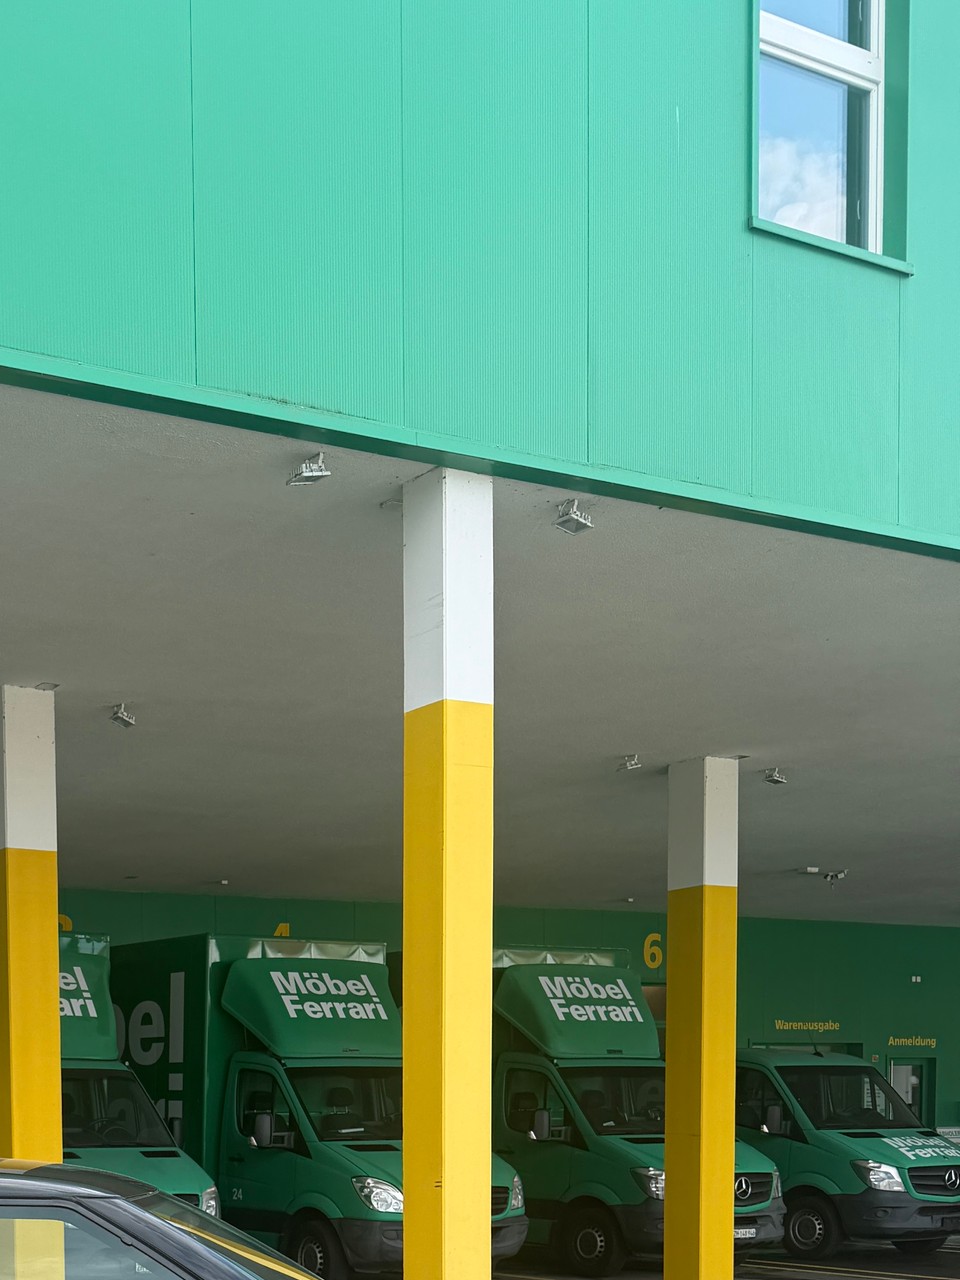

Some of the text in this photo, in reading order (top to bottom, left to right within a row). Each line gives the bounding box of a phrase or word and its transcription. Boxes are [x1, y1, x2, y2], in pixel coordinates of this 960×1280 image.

[643, 933, 663, 969] 6
[269, 971, 378, 997] Möbel
[538, 976, 633, 1000] Möbel
[280, 994, 389, 1020] Ferrari
[549, 998, 644, 1022] Ferrari
[774, 1019, 841, 1033] Warenausgabe
[888, 1036, 937, 1049] Anmeldung
[881, 1136, 953, 1149] Möbel
[232, 1188, 243, 1201] 24
